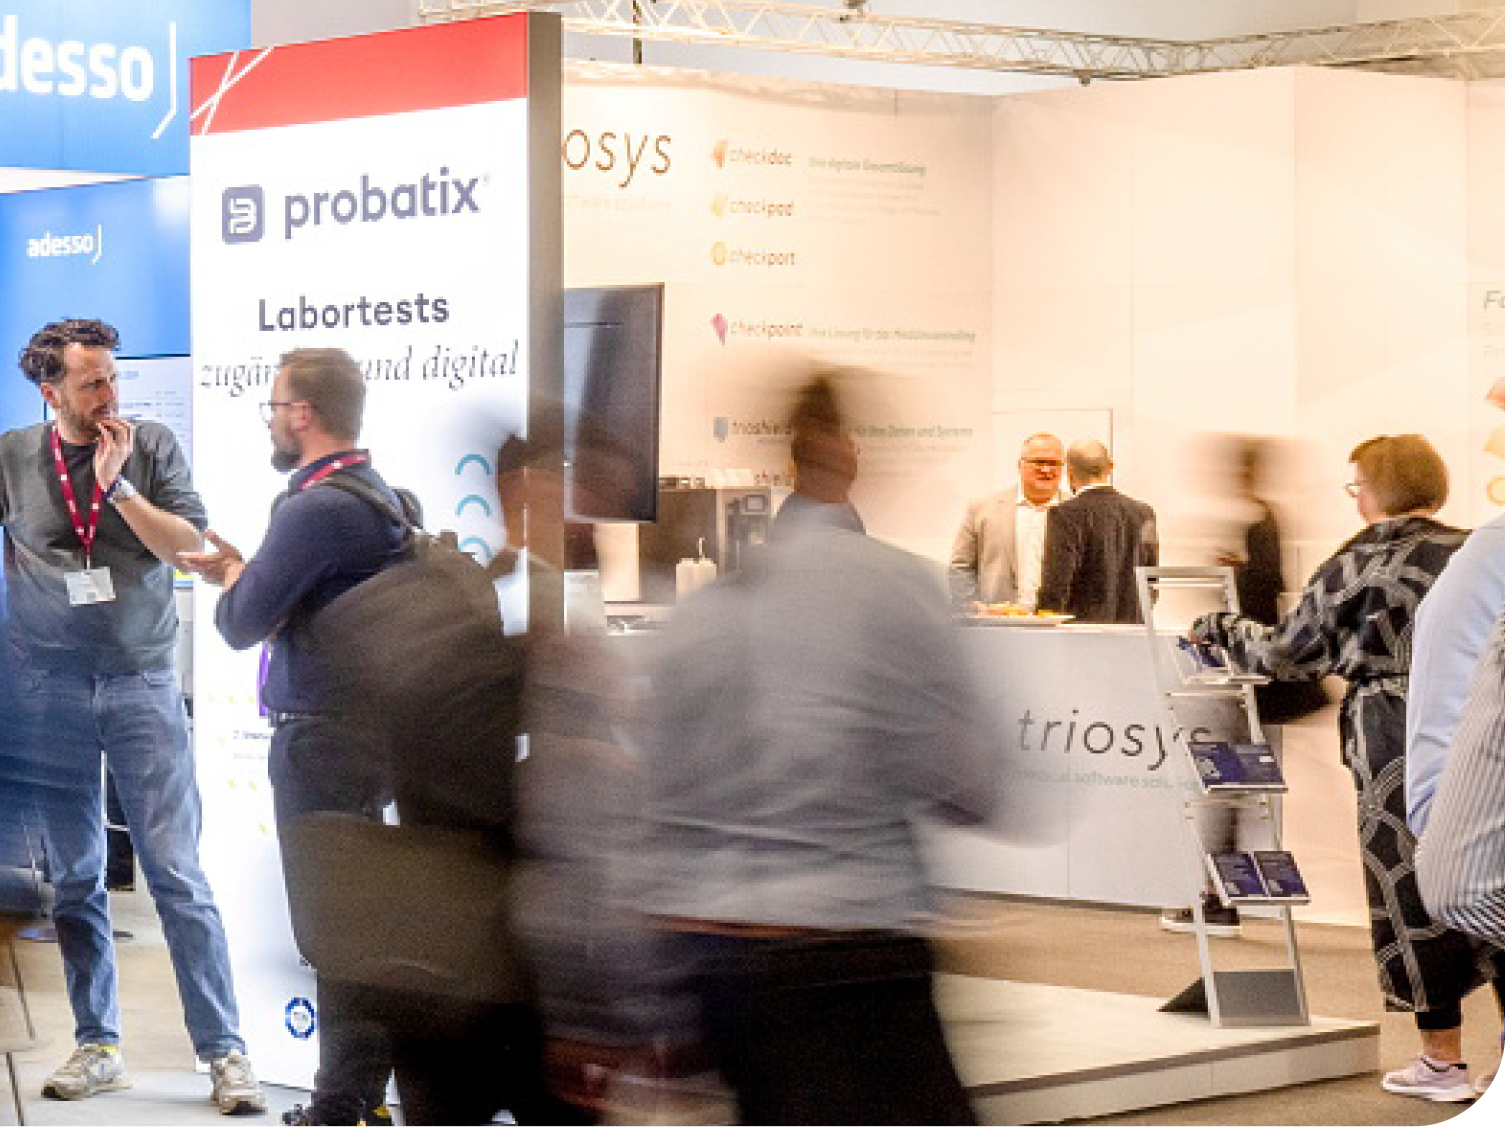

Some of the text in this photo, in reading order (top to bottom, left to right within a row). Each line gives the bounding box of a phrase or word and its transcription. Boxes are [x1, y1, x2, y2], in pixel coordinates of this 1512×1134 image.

[283, 165, 480, 244] probatix
[27, 231, 94, 258] adesso
[258, 291, 451, 333] Labortests
[422, 338, 520, 392] digital
